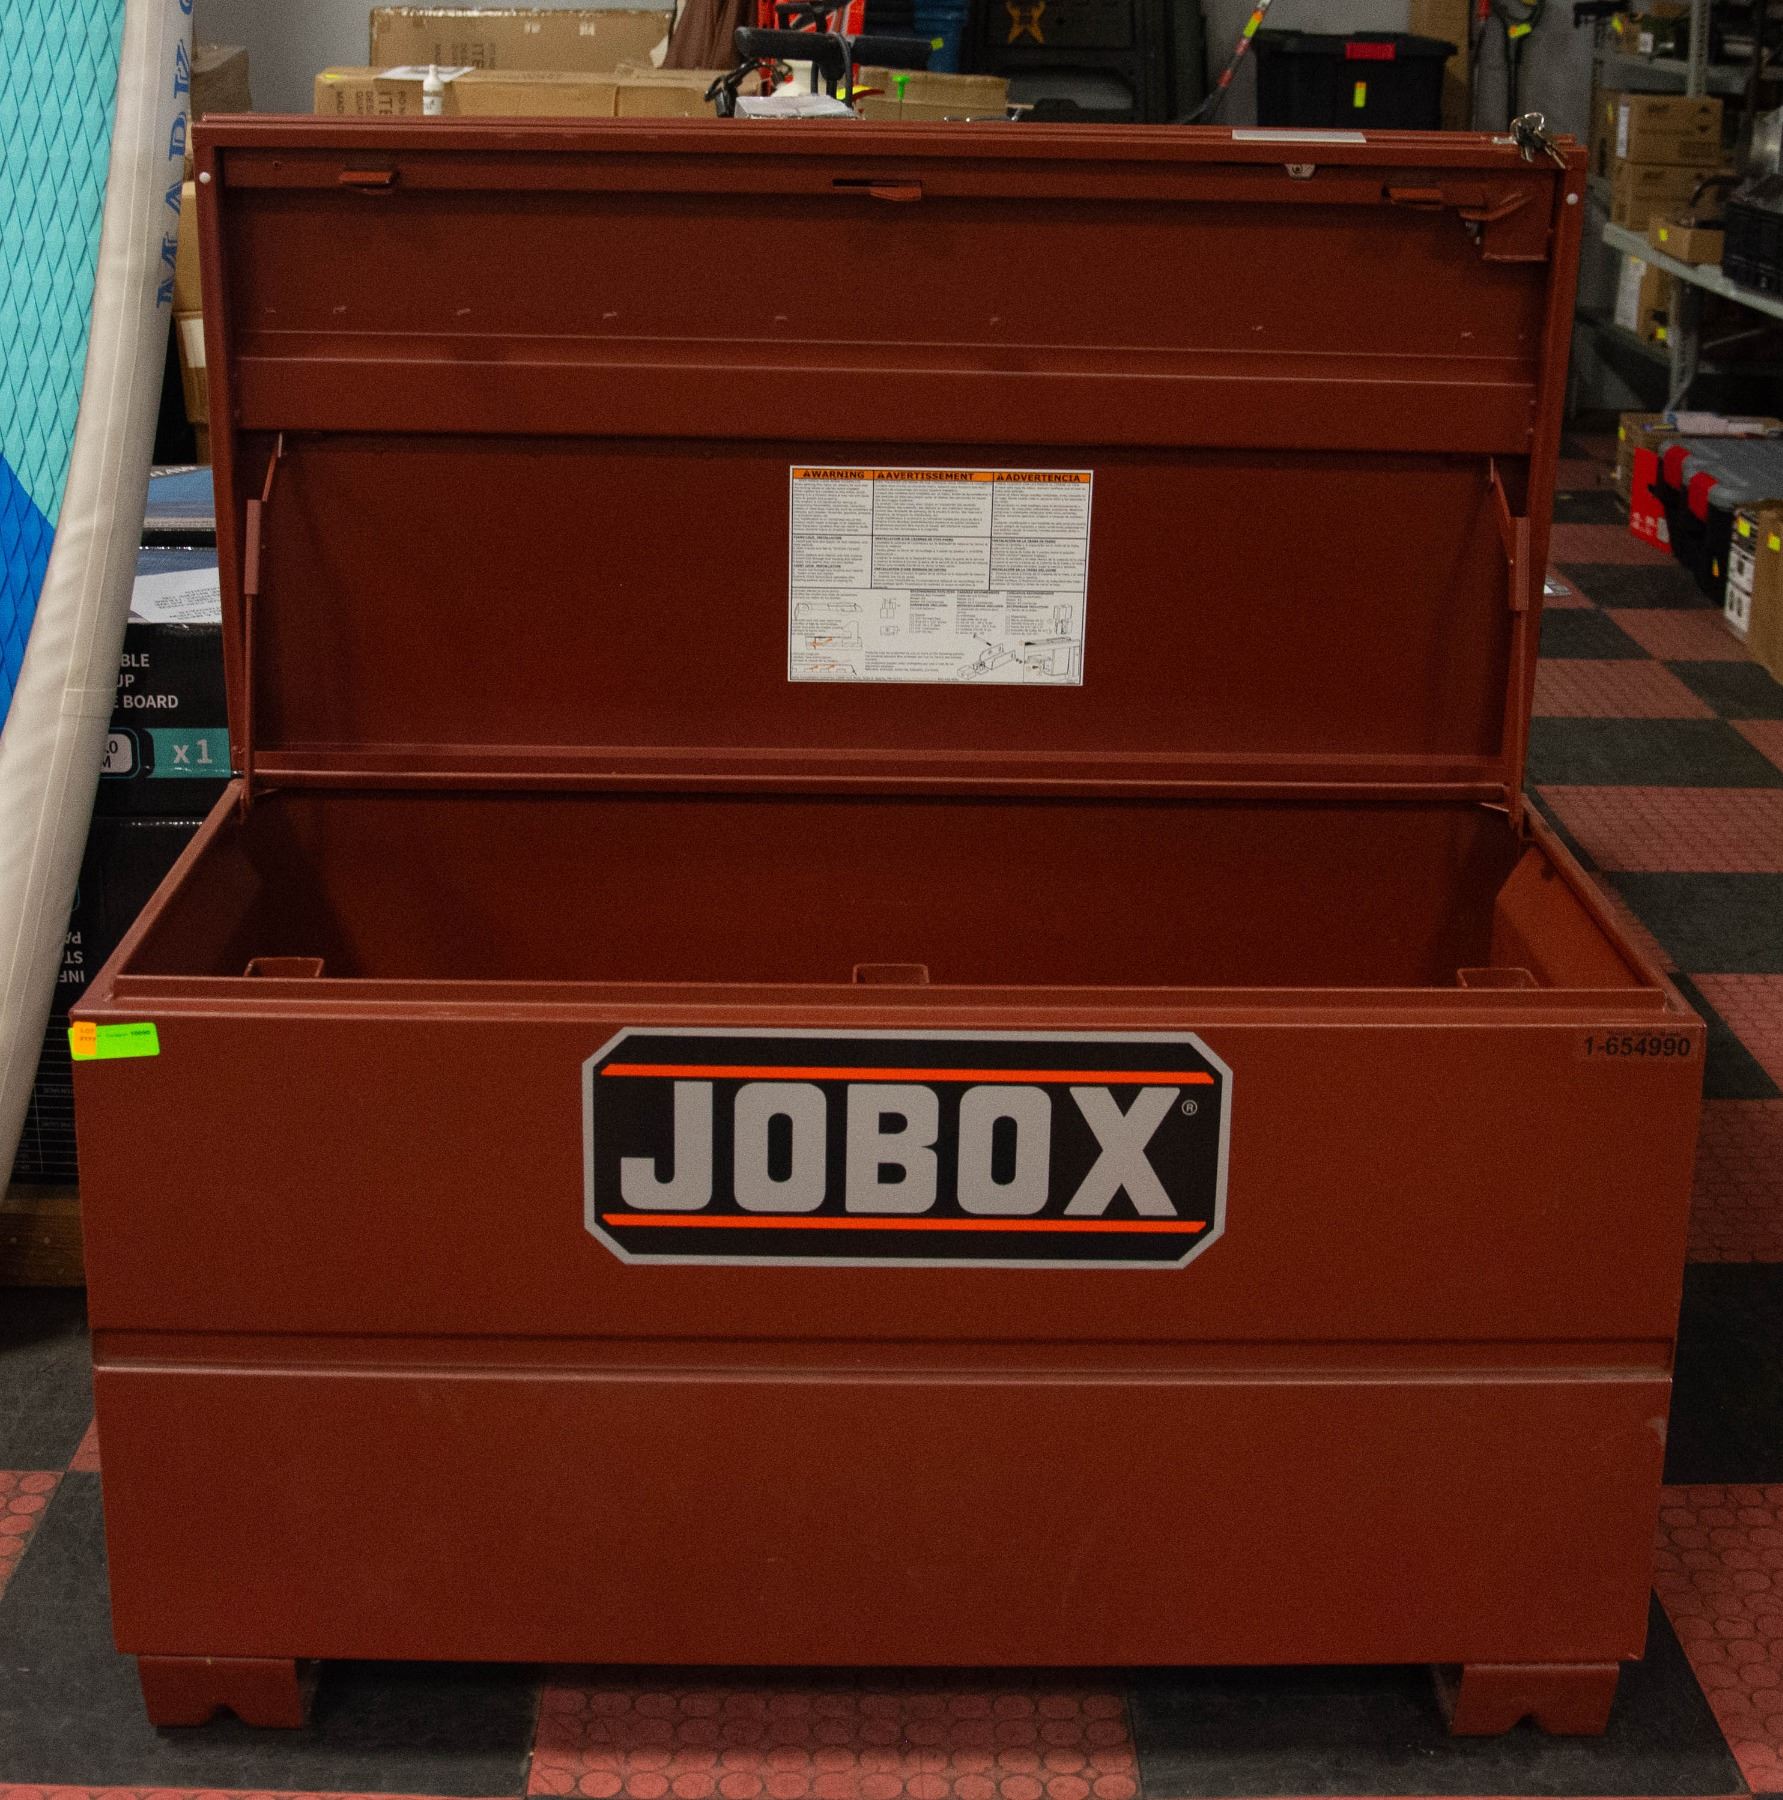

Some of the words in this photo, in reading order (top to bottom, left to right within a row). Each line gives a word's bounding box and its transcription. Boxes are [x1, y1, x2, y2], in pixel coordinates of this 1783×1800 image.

[811, 471, 865, 479] WARNING
[886, 472, 974, 481] AVERTISSEMENT
[1005, 473, 1080, 483] ADVERTENCIA
[123, 695, 179, 709] BOARD
[1584, 1035, 1692, 1057] 1-654990
[620, 1080, 1180, 1216] JOBOX
